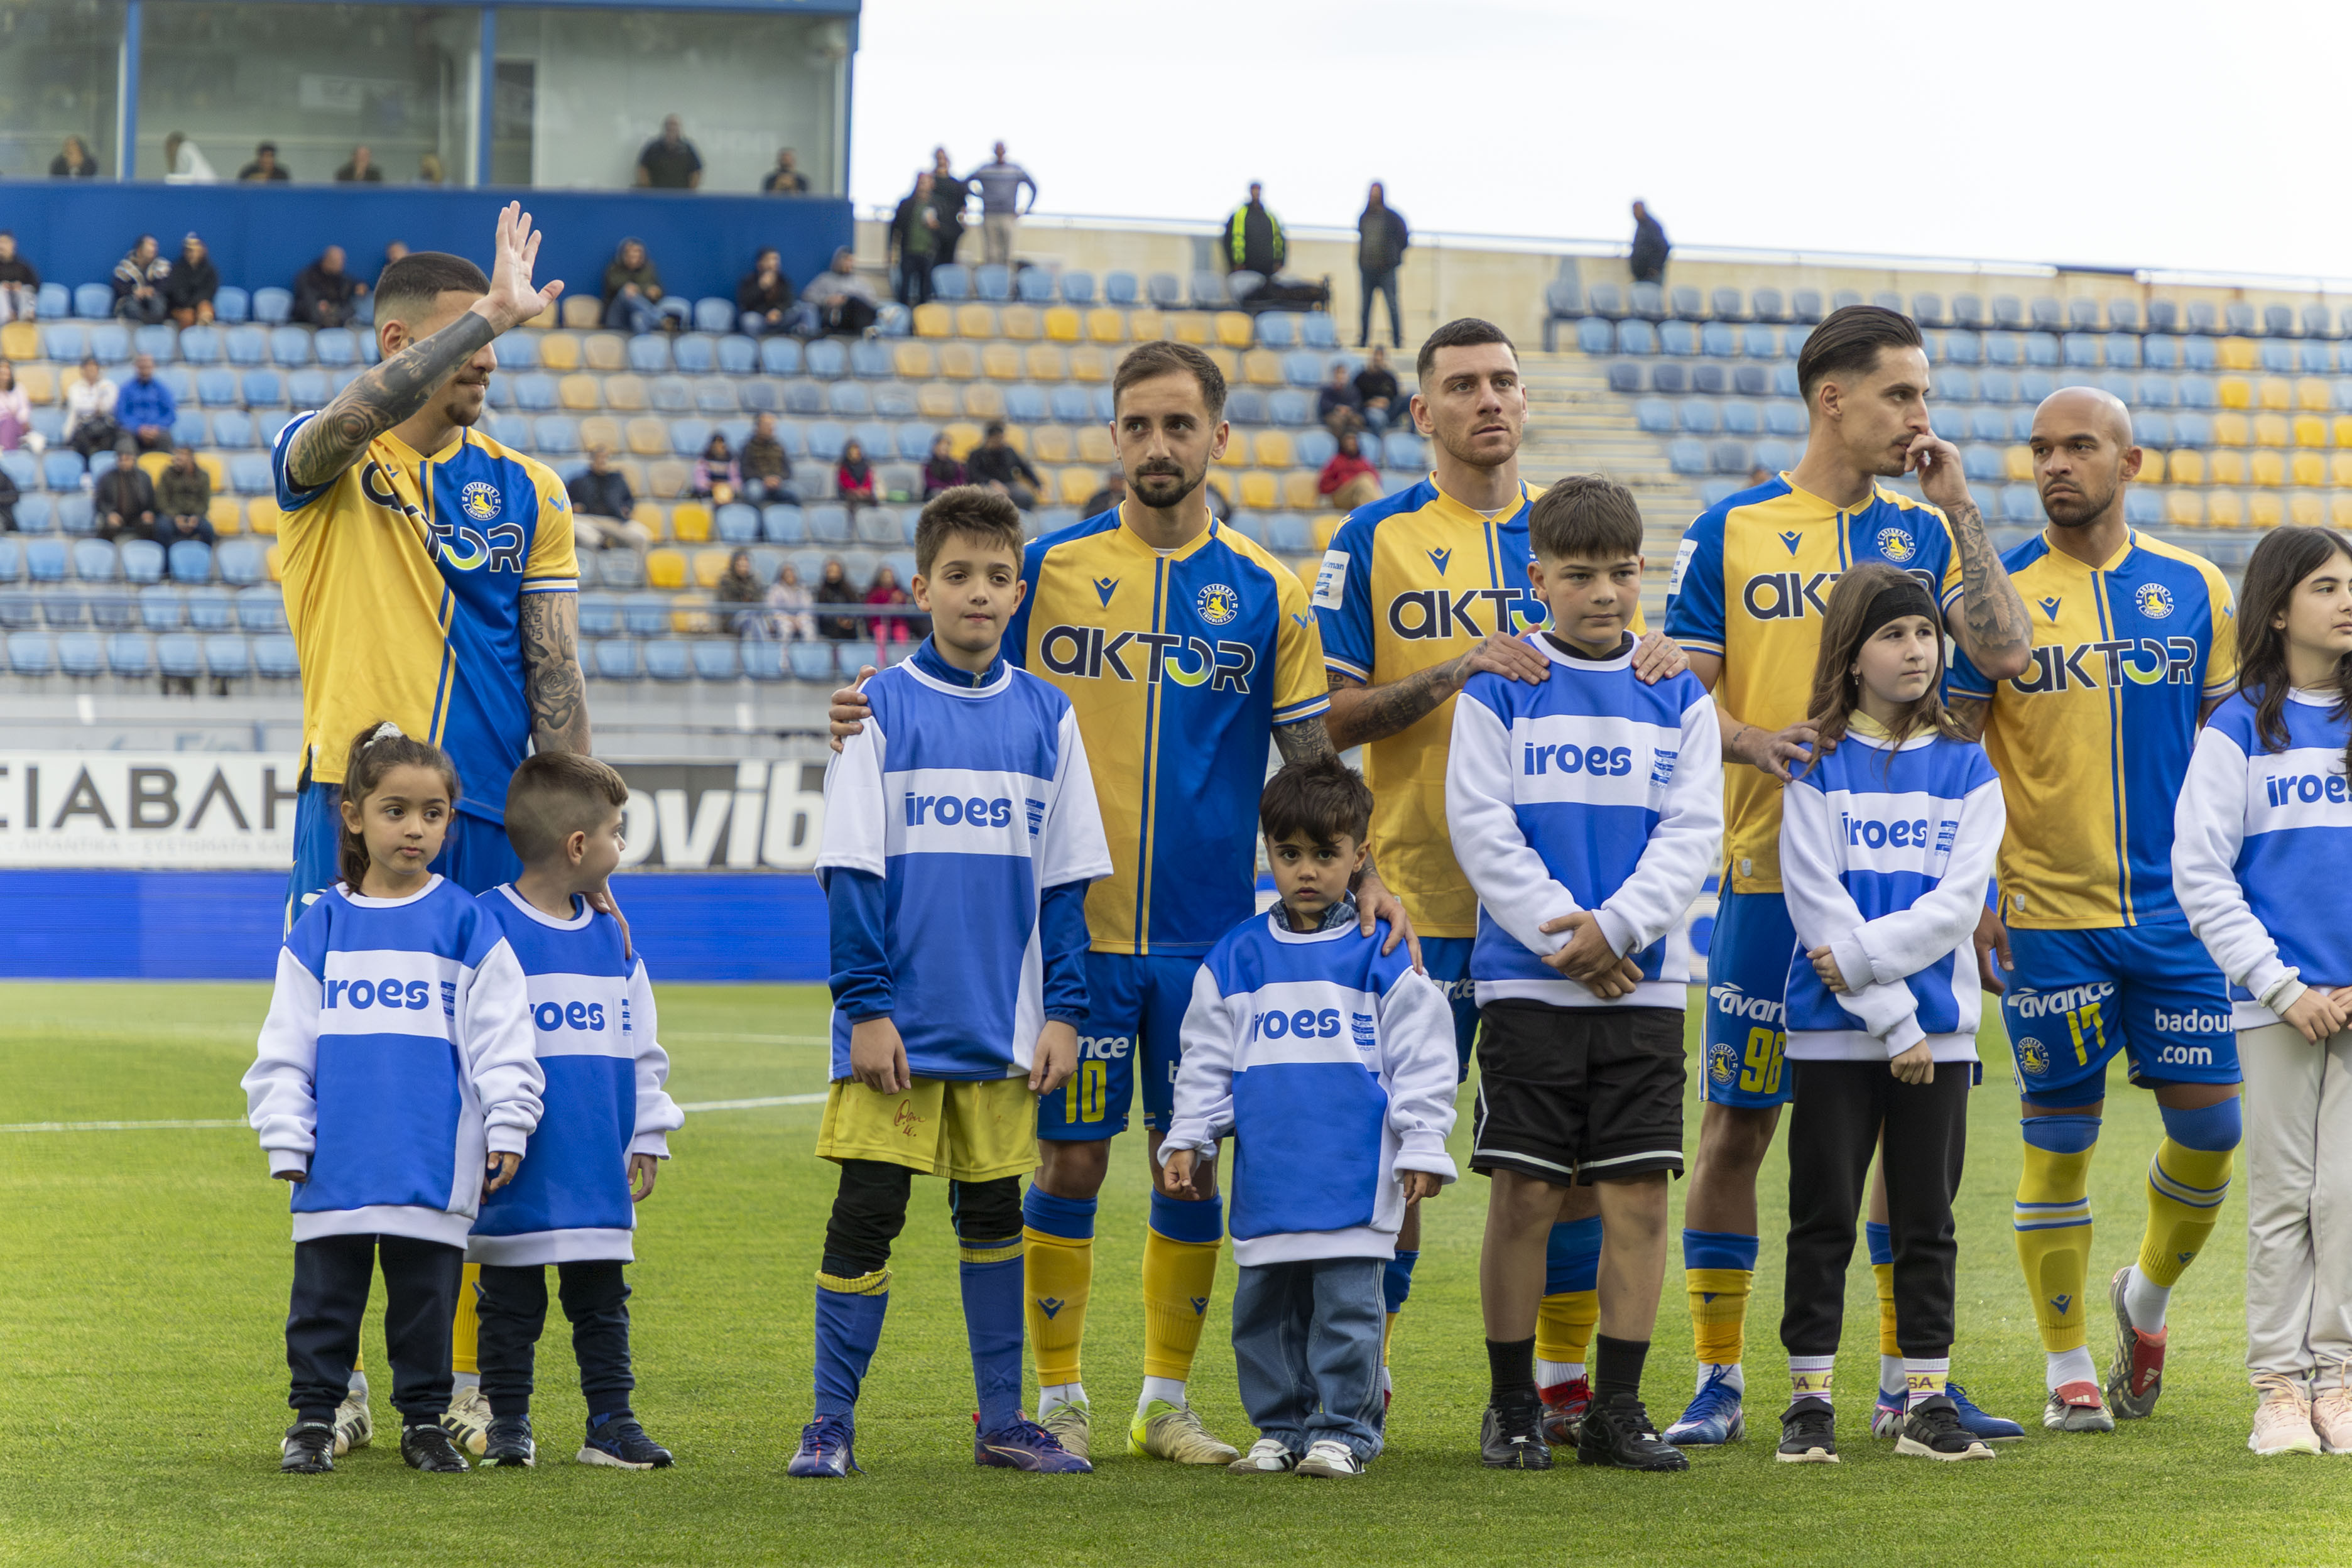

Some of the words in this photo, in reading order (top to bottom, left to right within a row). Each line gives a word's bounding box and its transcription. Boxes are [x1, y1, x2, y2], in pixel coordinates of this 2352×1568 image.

[1524, 742, 1631, 776] iroes
[905, 792, 1012, 828] iroes
[2066, 1002, 2106, 1066] 17
[2158, 1046, 2212, 1065] .com
